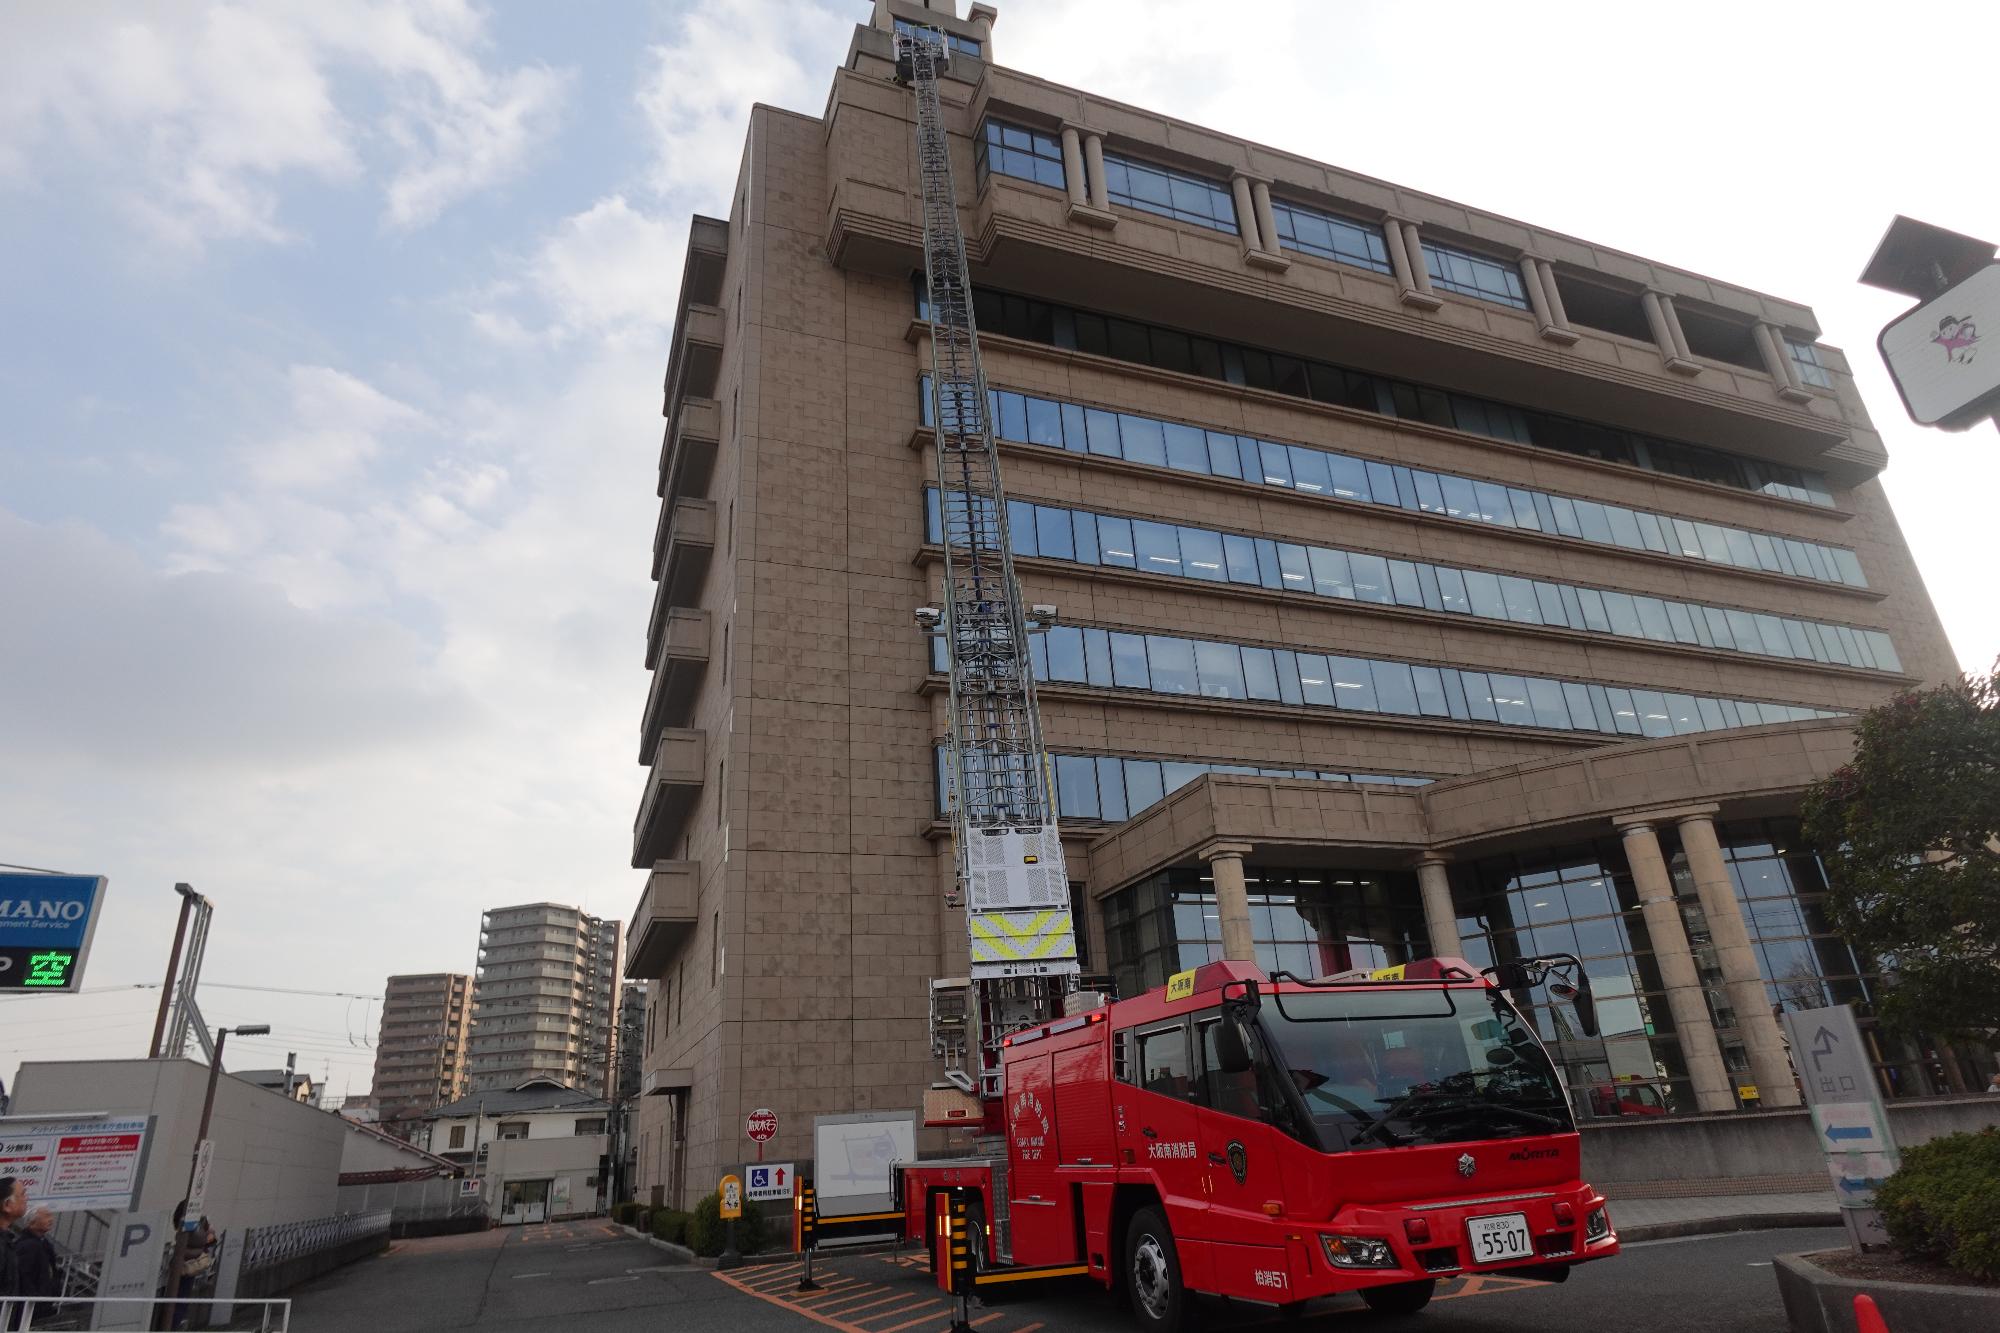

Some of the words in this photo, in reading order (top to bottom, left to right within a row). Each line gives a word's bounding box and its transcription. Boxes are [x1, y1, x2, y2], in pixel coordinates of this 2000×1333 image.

[31, 920, 71, 929] Service
[24, 951, 72, 986] 空
[1171, 977, 1191, 994] 大阪南
[1819, 1076, 1857, 1092] 出口
[1148, 1141, 1197, 1159] 大阪南消防局
[1508, 1147, 1560, 1160] MORITA
[120, 1224, 151, 1258] P
[1482, 1229, 1525, 1256] 55-07
